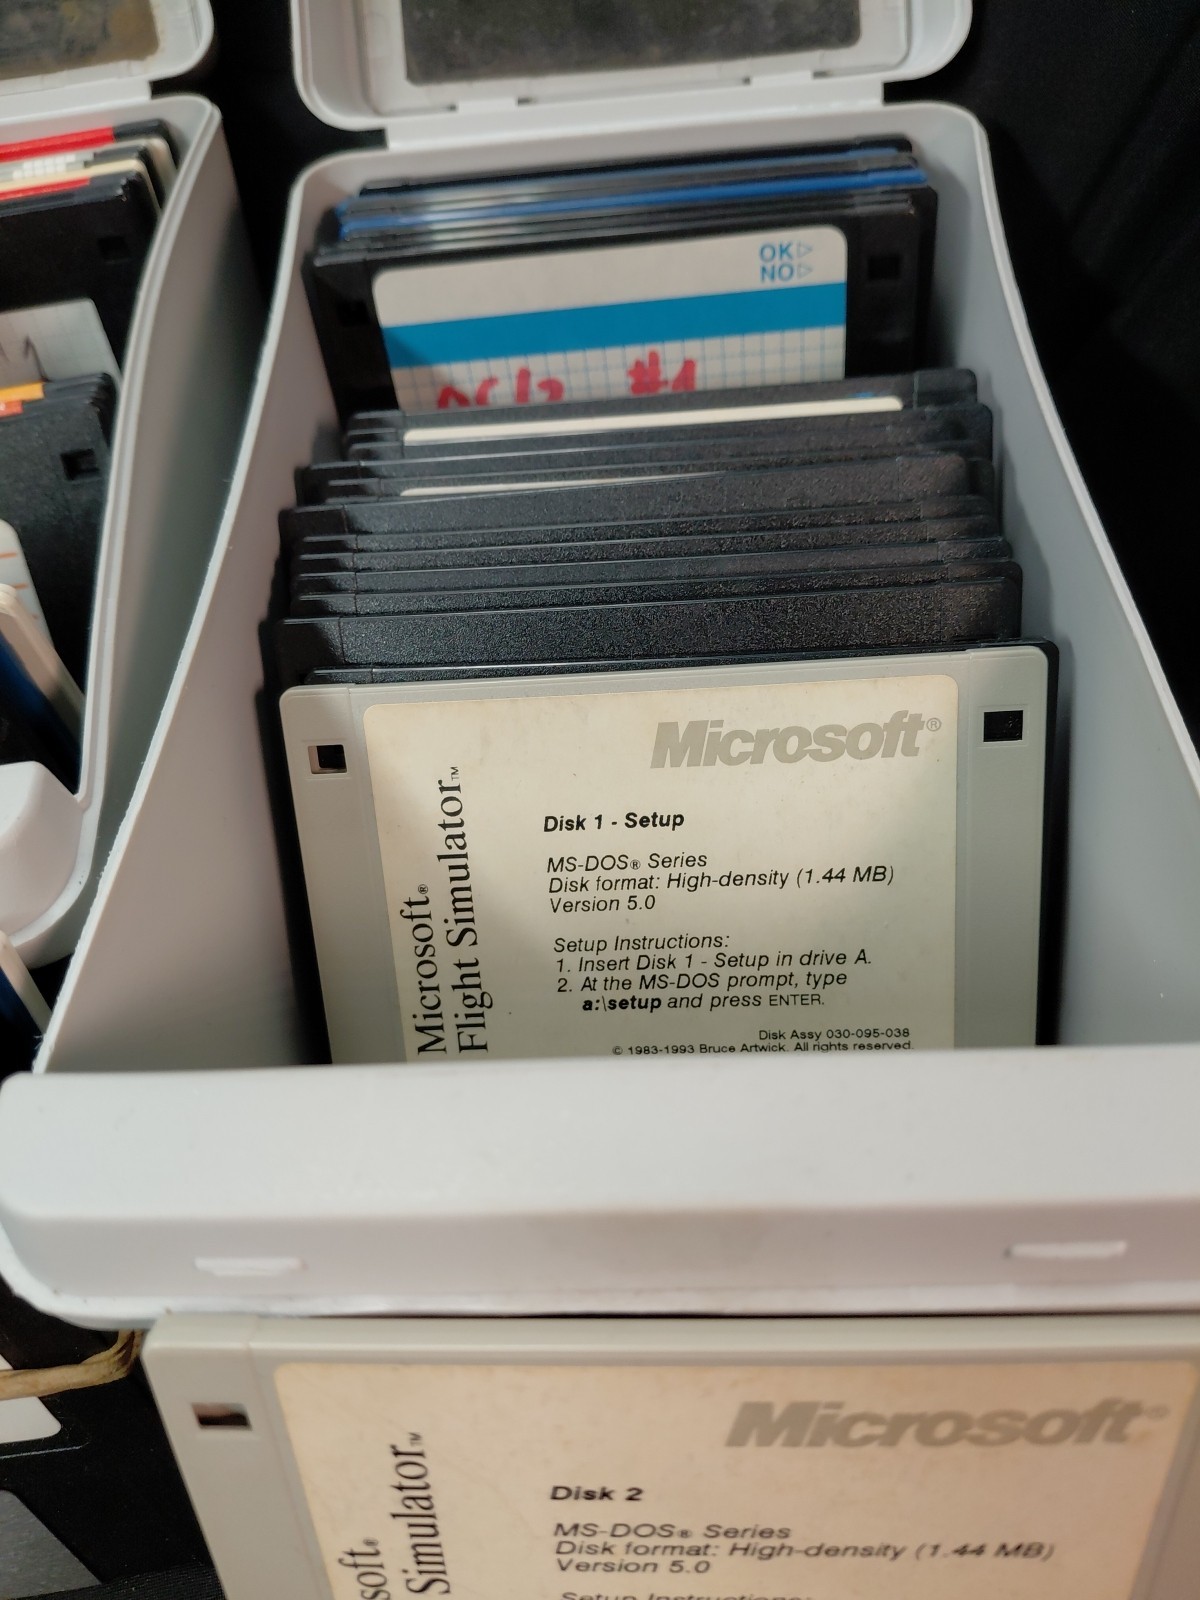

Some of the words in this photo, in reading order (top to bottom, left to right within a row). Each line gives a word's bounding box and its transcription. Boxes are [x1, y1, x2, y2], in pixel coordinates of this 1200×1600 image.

[759, 241, 795, 263] OK
[760, 262, 795, 283] NO
[543, 815, 587, 832] Disk
[594, 814, 604, 830] 1
[624, 812, 685, 831] Setup
[647, 853, 708, 870] Series
[548, 875, 590, 893] Disk
[594, 873, 661, 892] format:
[666, 870, 790, 893] High-density
[796, 867, 847, 889] (1.44
[852, 865, 895, 886] MB)
[550, 895, 621, 914] Version
[626, 895, 657, 911] 5.0
[553, 937, 608, 956] Setup
[613, 933, 730, 952] Instructions:
[556, 958, 572, 973] 1.
[577, 955, 630, 972] Insert
[635, 954, 677, 971] Disk
[684, 954, 694, 968] 1
[713, 952, 770, 972] Setup
[776, 952, 793, 967] in
[798, 950, 848, 967] drive
[853, 949, 873, 965] A.
[556, 977, 574, 993] 2.
[580, 976, 600, 992] At
[603, 975, 633, 991] the
[638, 972, 720, 990] MS-DOS
[726, 971, 799, 993] prompt,
[805, 971, 848, 990] type
[452, 955, 494, 1053] Flight
[582, 995, 662, 1014] a:\setup
[666, 993, 704, 1010] and
[709, 993, 763, 1012] press
[768, 993, 826, 1007] ENTER.
[758, 1029, 787, 1041] Disk
[790, 1029, 822, 1042] Assy
[825, 1027, 911, 1040] 030-095-038
[627, 1044, 696, 1056] 1983-1993
[699, 1043, 736, 1054] Bruce
[739, 1041, 790, 1053] Artwick.
[793, 1041, 810, 1052] All
[812, 1040, 850, 1053] rights
[852, 1039, 915, 1051] reserved.
[549, 1485, 616, 1502] Disk
[624, 1486, 645, 1502] 2
[703, 1524, 792, 1541] Series
[555, 1540, 616, 1557] Disk
[623, 1540, 721, 1558] format:
[728, 1542, 907, 1562] High-density
[915, 1541, 987, 1562] (1.44
[994, 1541, 1057, 1562] MB)
[556, 1558, 659, 1574] Version
[668, 1559, 712, 1575] 5.0
